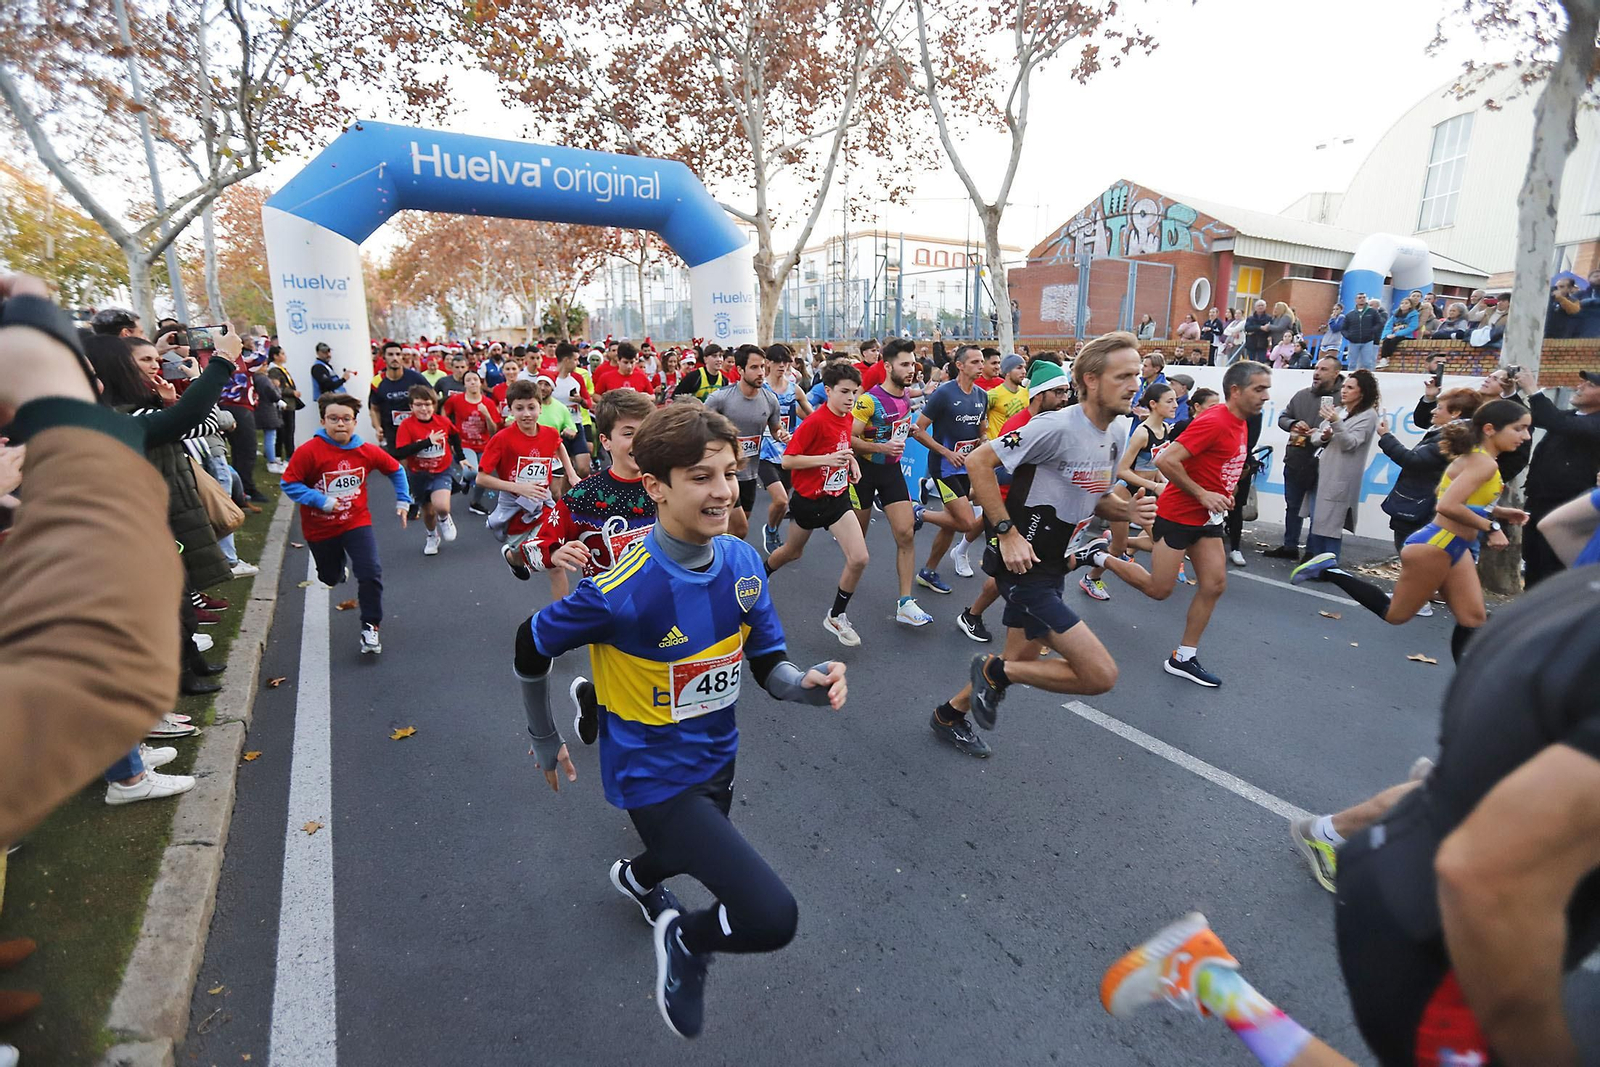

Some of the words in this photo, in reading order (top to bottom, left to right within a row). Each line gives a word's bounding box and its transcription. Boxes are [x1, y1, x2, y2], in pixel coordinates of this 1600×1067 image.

[410, 141, 549, 188] Huelva
[553, 162, 660, 202] original
[282, 273, 347, 291] Huelva
[527, 465, 545, 476] 574
[335, 476, 356, 489] 486
[658, 634, 689, 649] adidas
[696, 662, 740, 695] 485
